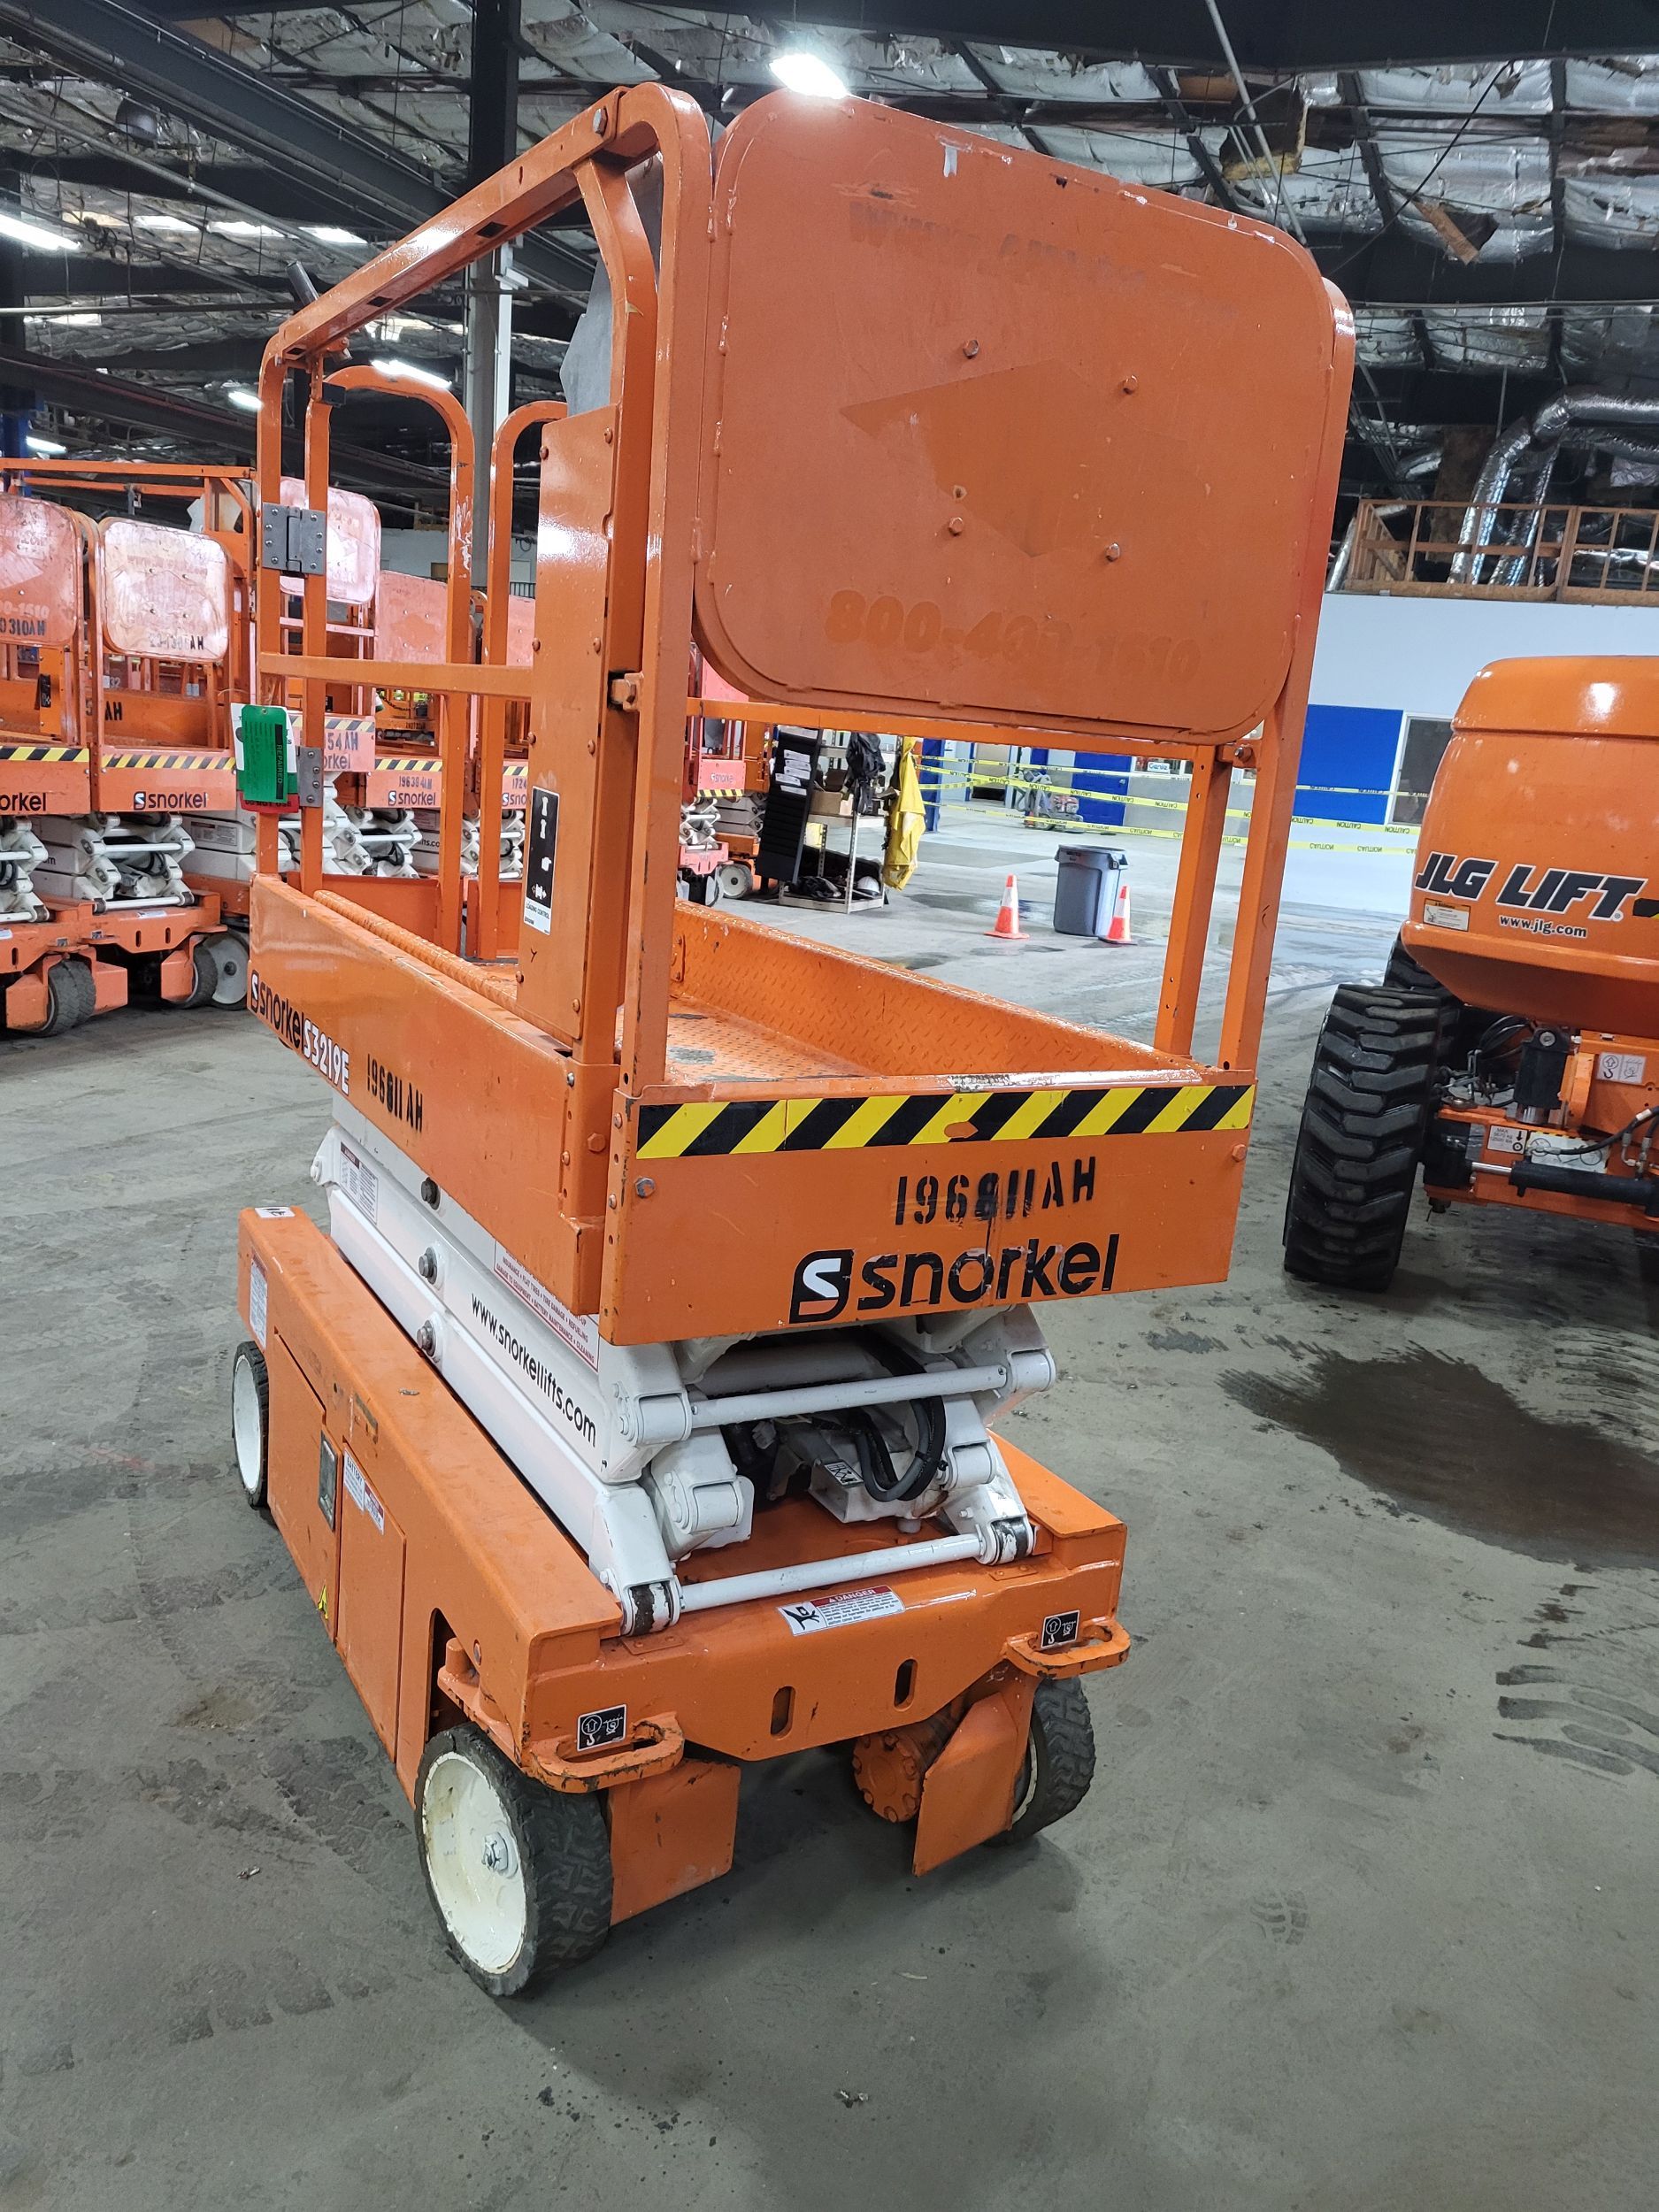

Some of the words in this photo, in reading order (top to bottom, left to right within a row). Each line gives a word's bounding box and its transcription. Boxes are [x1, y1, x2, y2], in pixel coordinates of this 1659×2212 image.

[325, 732, 358, 750] 54AH
[149, 793, 208, 809] snorkel
[398, 792, 436, 806] snorkel
[1337, 821, 1362, 830] CAUTION
[1416, 852, 1498, 901] JLG
[1496, 864, 1647, 921] LIFT
[1500, 915, 1586, 938] www.jlg.com
[259, 981, 304, 1051] snorkel
[303, 1018, 350, 1096] S3219E
[856, 1233, 1119, 1311] snorkel
[534, 1297, 549, 1318] BATTERY
[576, 1340, 595, 1364] CLEANING
[568, 1317, 588, 1343] REFUELING
[472, 1293, 595, 1448] www.snorkellifts.com
[835, 1589, 877, 1601] DANGER
